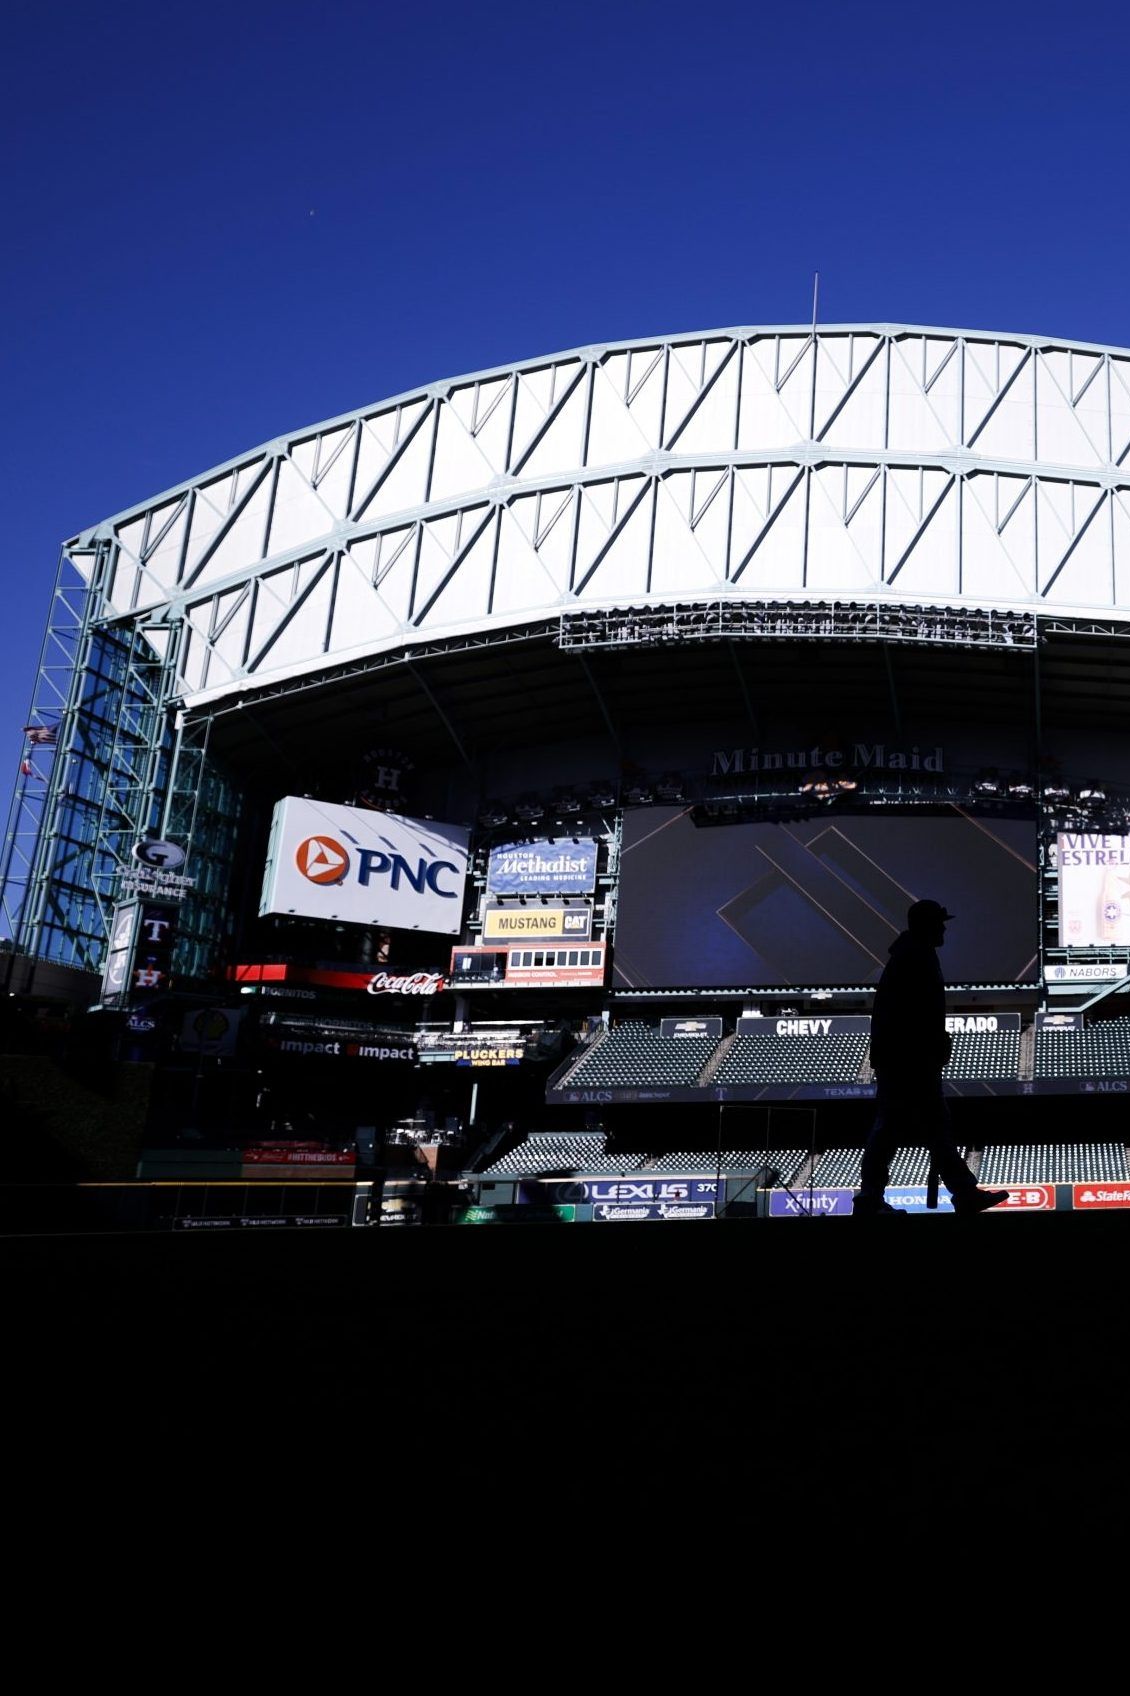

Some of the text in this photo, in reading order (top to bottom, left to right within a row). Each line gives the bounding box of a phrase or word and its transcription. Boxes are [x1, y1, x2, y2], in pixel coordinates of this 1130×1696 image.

[711, 743, 944, 776] Minute Maid
[374, 765, 401, 792] H
[496, 856, 588, 874] Methodist
[355, 848, 460, 898] PNC
[121, 880, 189, 899] INSURANCE
[498, 915, 587, 930] MUSTANG CAT
[144, 919, 170, 942] T
[1069, 967, 1117, 978] NABORS
[776, 1019, 832, 1035] CHEVY
[945, 1017, 998, 1032] ERADO
[280, 1041, 415, 1060] impact impact
[454, 1049, 524, 1059] PLUCKERS
[824, 1088, 860, 1096] TEXAS
[1097, 1080, 1128, 1092] ALCS
[580, 1090, 613, 1102] ALCS
[591, 1184, 687, 1199] LEXUS
[1007, 1192, 1040, 1204] E-B
[785, 1194, 838, 1212] xfinity
[888, 1196, 951, 1205] HONA
